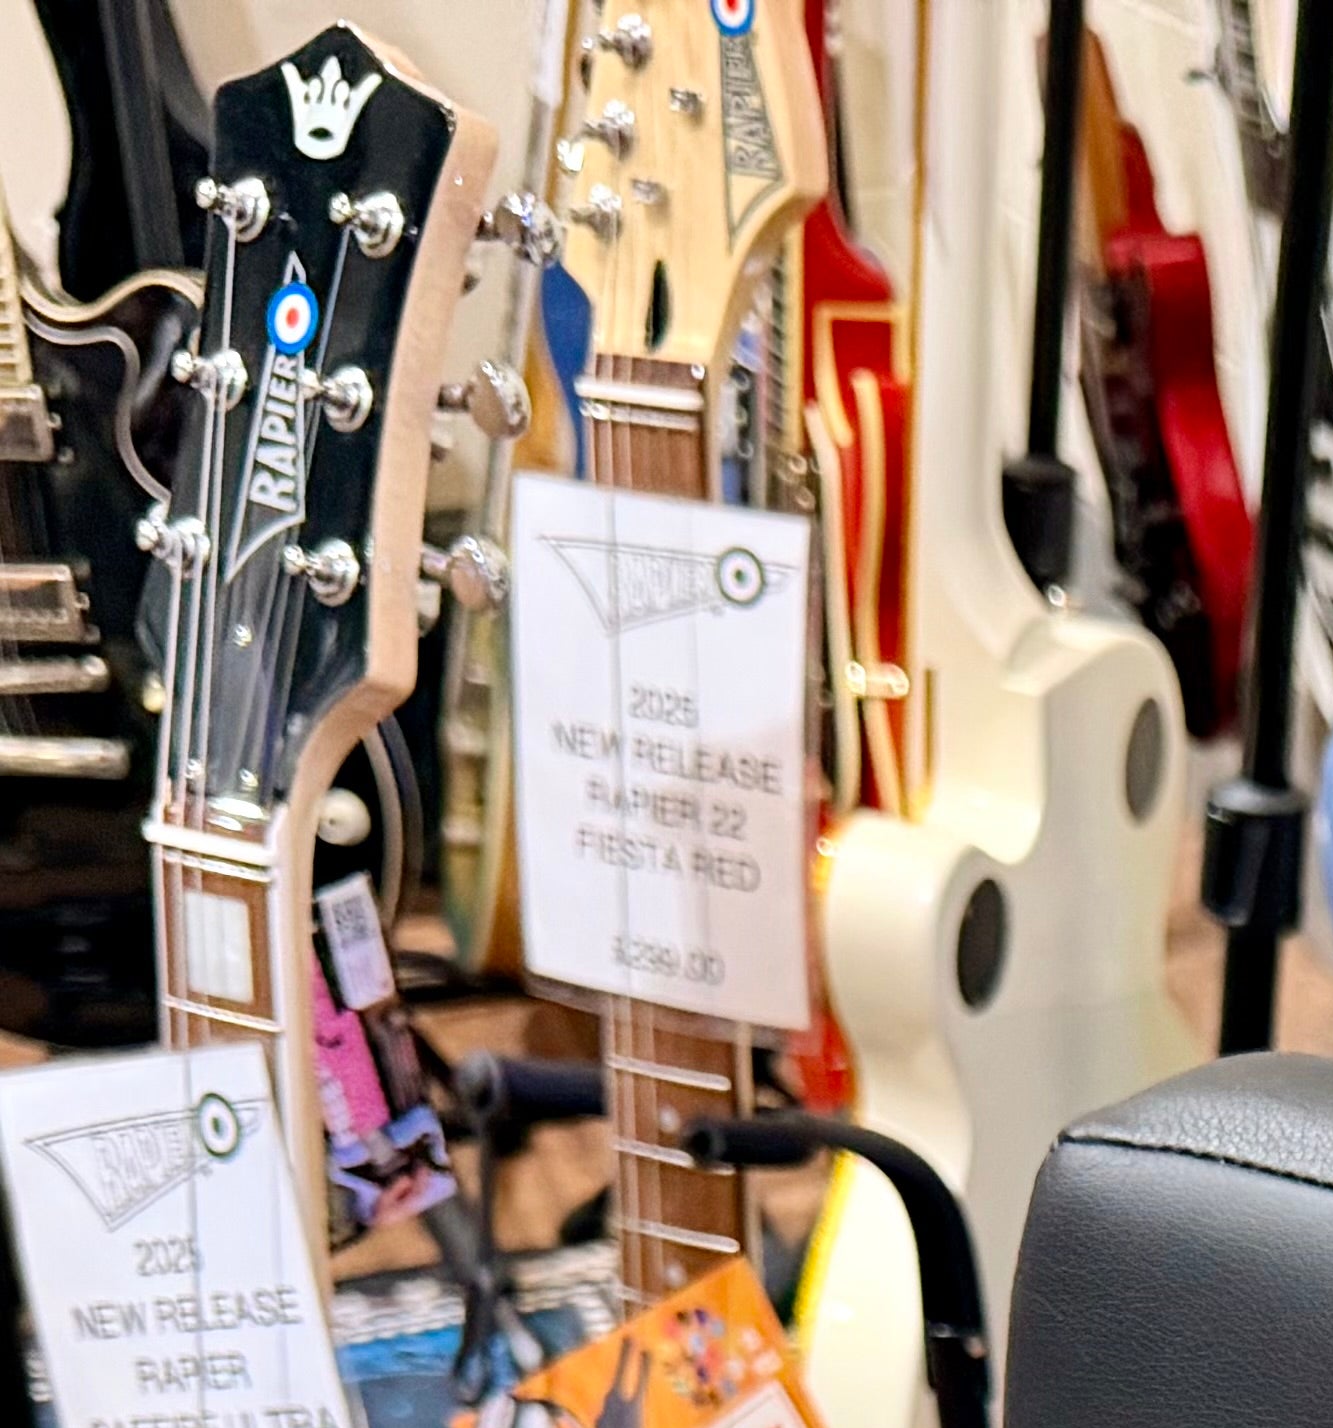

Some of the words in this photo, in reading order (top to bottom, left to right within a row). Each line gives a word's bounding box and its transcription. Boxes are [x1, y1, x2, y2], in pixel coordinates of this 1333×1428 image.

[250, 355, 296, 513] RAPIER
[73, 1302, 149, 1340] NEW
[156, 1285, 302, 1333] RELEASE
